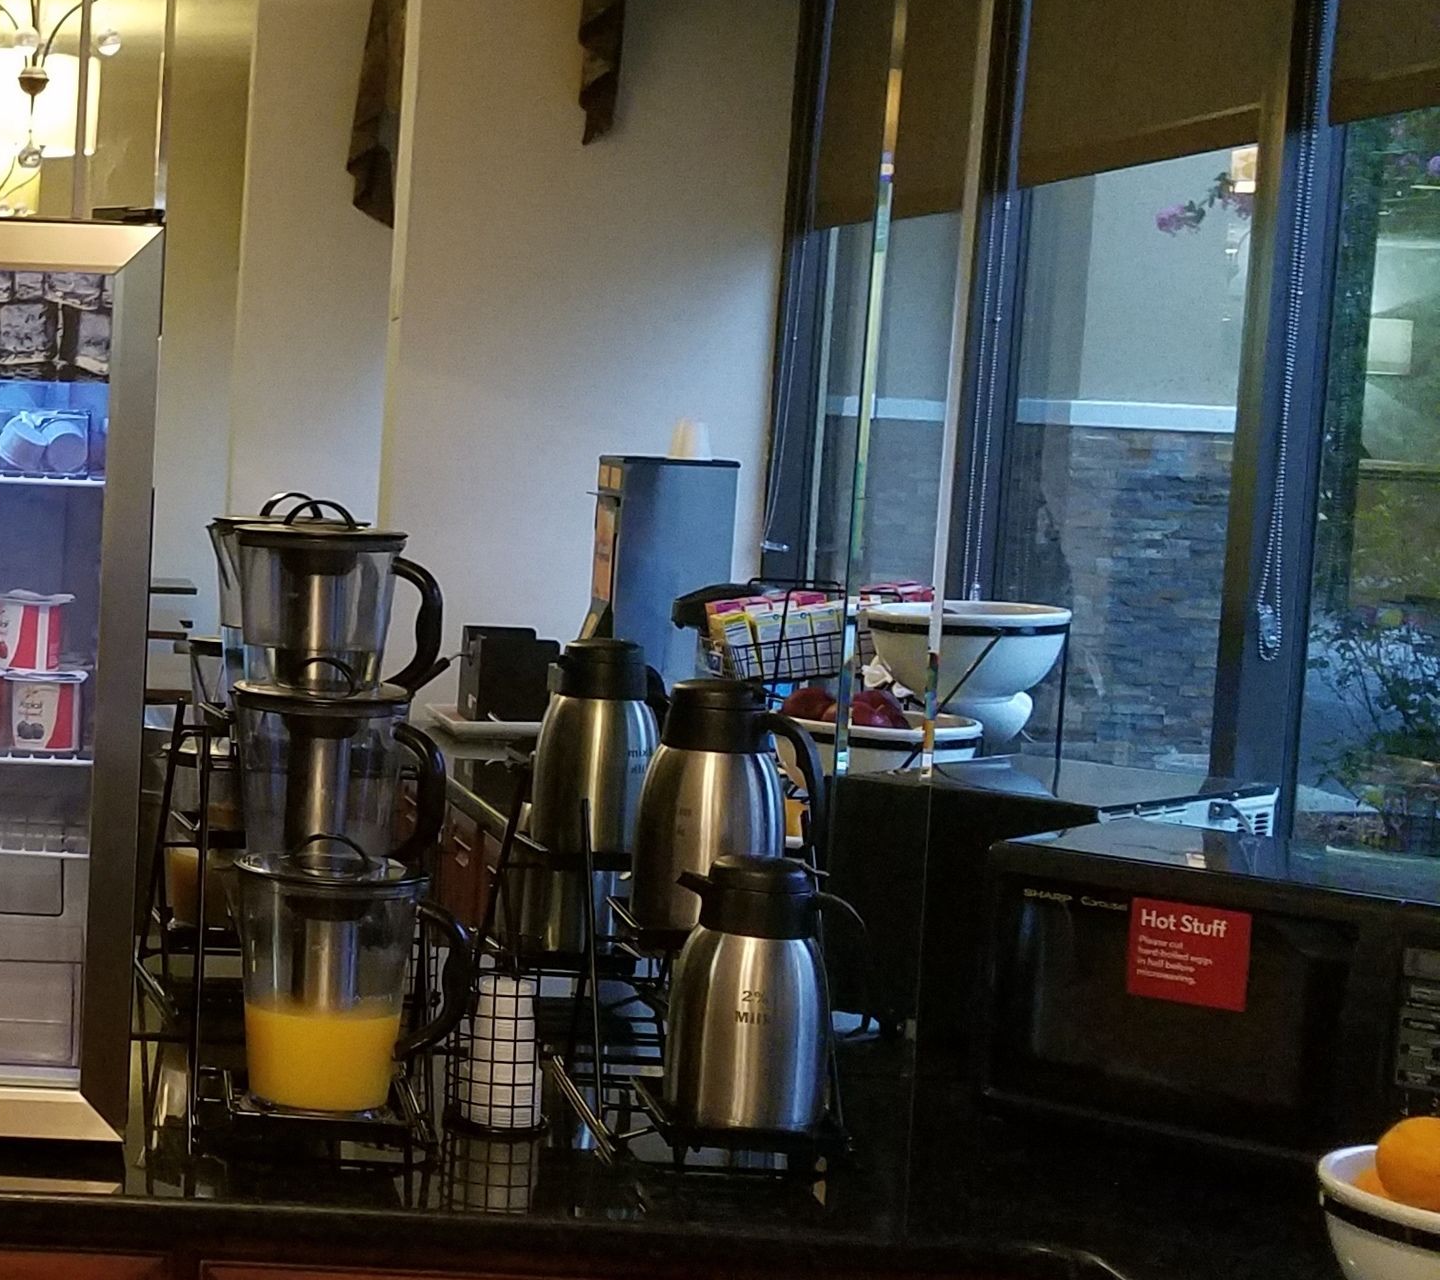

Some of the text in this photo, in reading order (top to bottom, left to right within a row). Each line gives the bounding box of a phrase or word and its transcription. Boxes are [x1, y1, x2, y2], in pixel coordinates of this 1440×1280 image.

[1023, 888, 1072, 901] SHARP
[1140, 908, 1228, 938] Hot Stuff
[741, 990, 768, 1003] 2%
